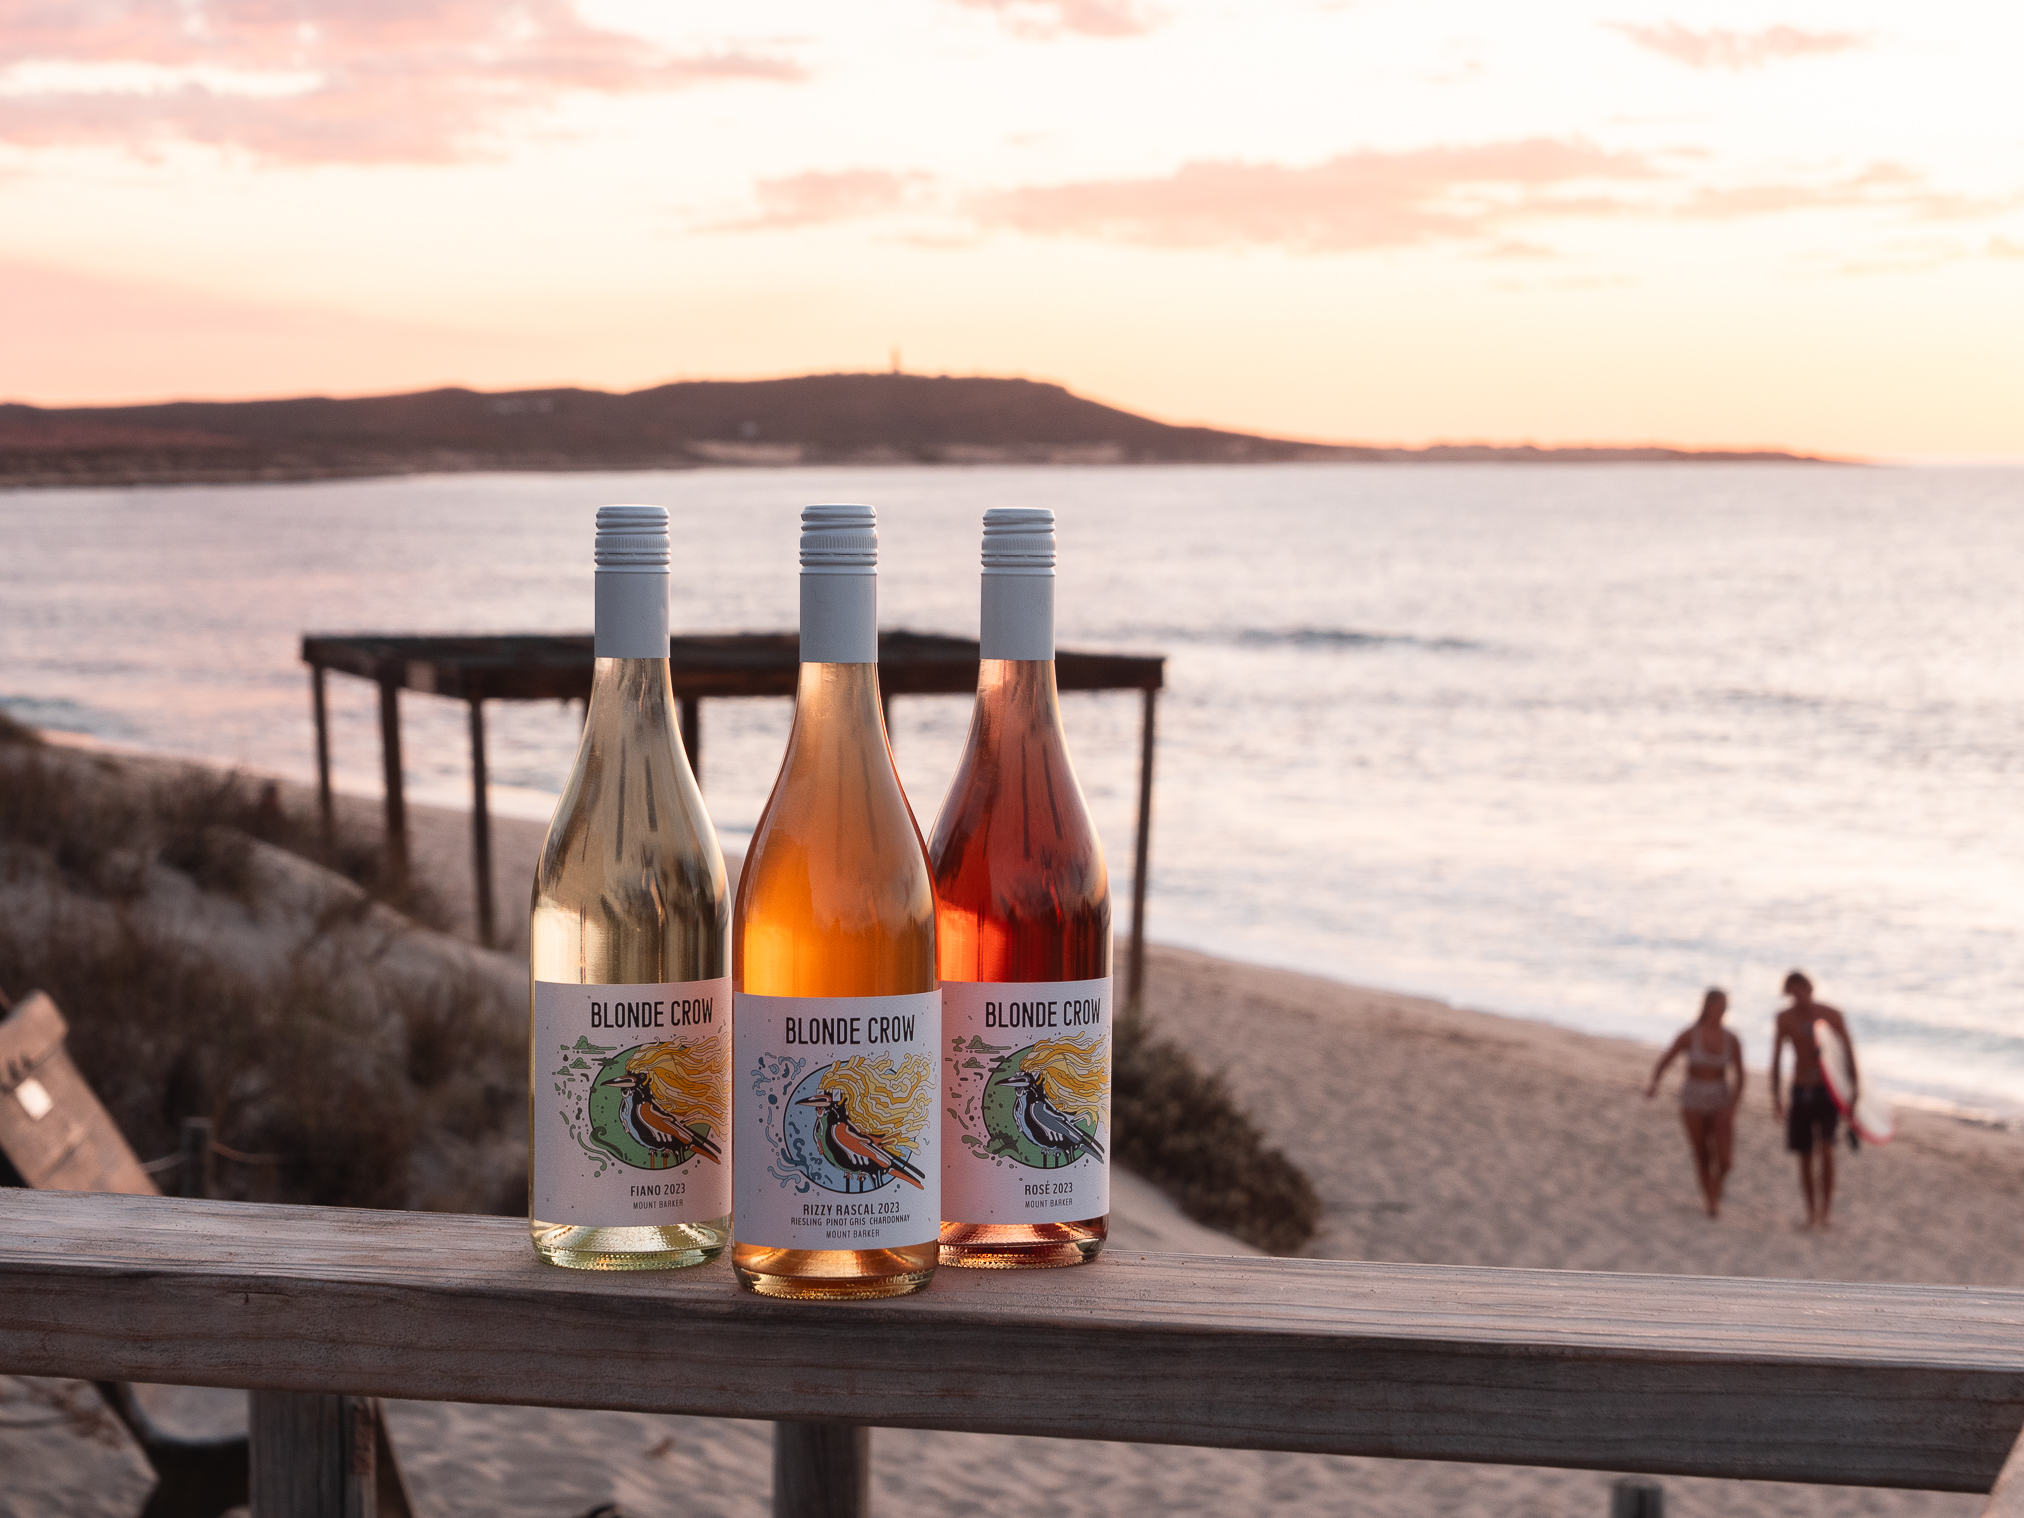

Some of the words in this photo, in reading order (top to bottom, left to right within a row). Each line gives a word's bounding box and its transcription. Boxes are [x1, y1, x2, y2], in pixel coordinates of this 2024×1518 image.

[591, 1001, 664, 1028] BLONDE
[670, 997, 713, 1026] CROW
[985, 1001, 1057, 1028] BLONDE
[1063, 997, 1101, 1026] CROW
[785, 1016, 861, 1045] BLONDE
[868, 1014, 915, 1043] CROW
[630, 1184, 661, 1197] FIANO
[664, 1182, 686, 1195] 2023
[1024, 1180, 1050, 1195] ROSÉ
[1052, 1181, 1073, 1194] 2023
[633, 1200, 656, 1210] MOUNT
[658, 1198, 684, 1209] BARKER
[803, 1204, 833, 1216] RIZZY
[836, 1203, 875, 1216] RASCAL
[878, 1201, 900, 1215] 2023
[1024, 1199, 1048, 1208] MOUNT
[1050, 1197, 1073, 1208] BARKER
[790, 1217, 822, 1226] RIESLING
[826, 1217, 847, 1227] PINOT
[849, 1217, 866, 1226] GRIS
[869, 1214, 910, 1225] CHARDONNAY
[825, 1230, 850, 1239] MOUNT
[853, 1229, 880, 1238] BARKER
